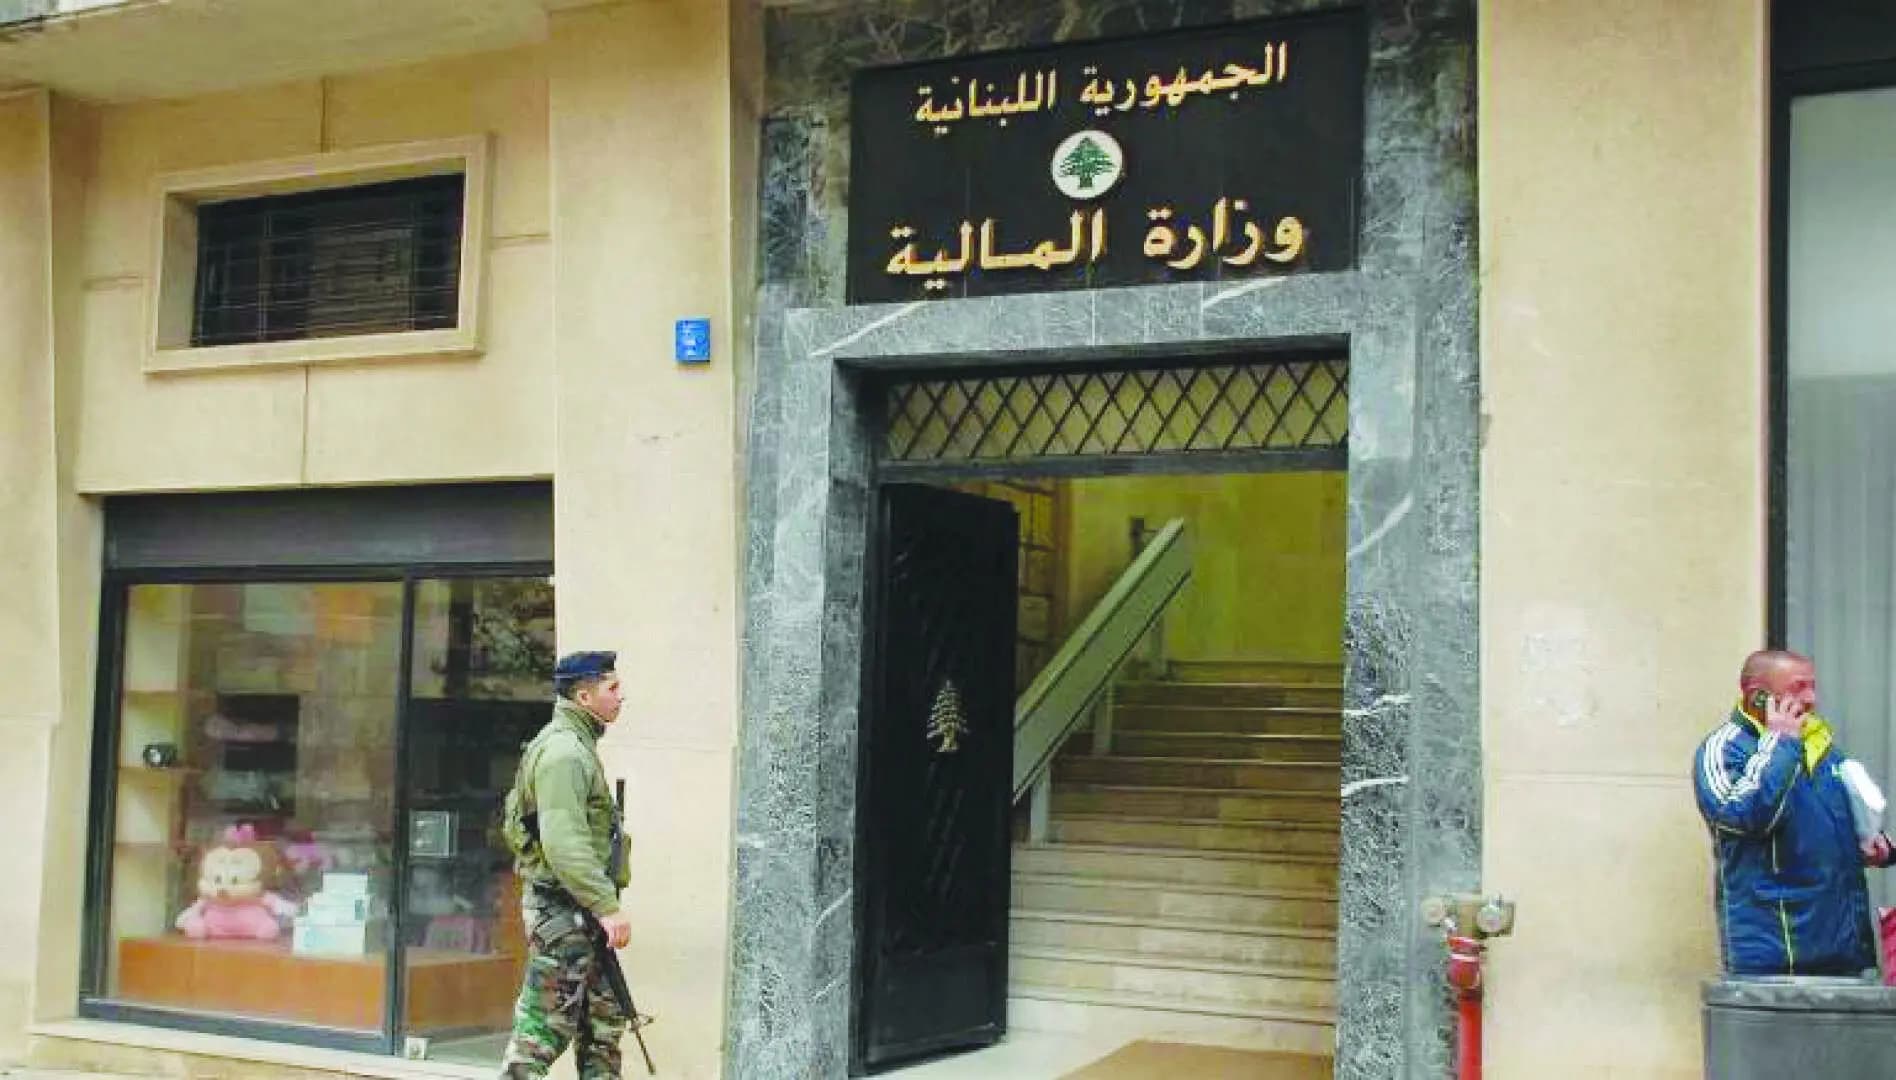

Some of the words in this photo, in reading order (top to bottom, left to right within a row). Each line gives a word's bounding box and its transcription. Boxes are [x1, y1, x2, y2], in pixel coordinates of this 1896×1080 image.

[915, 69, 1057, 135] اللبنانية
[1079, 40, 1288, 117] الجمهورية
[886, 207, 1106, 291] المالية
[1143, 196, 1305, 270] وزارة
